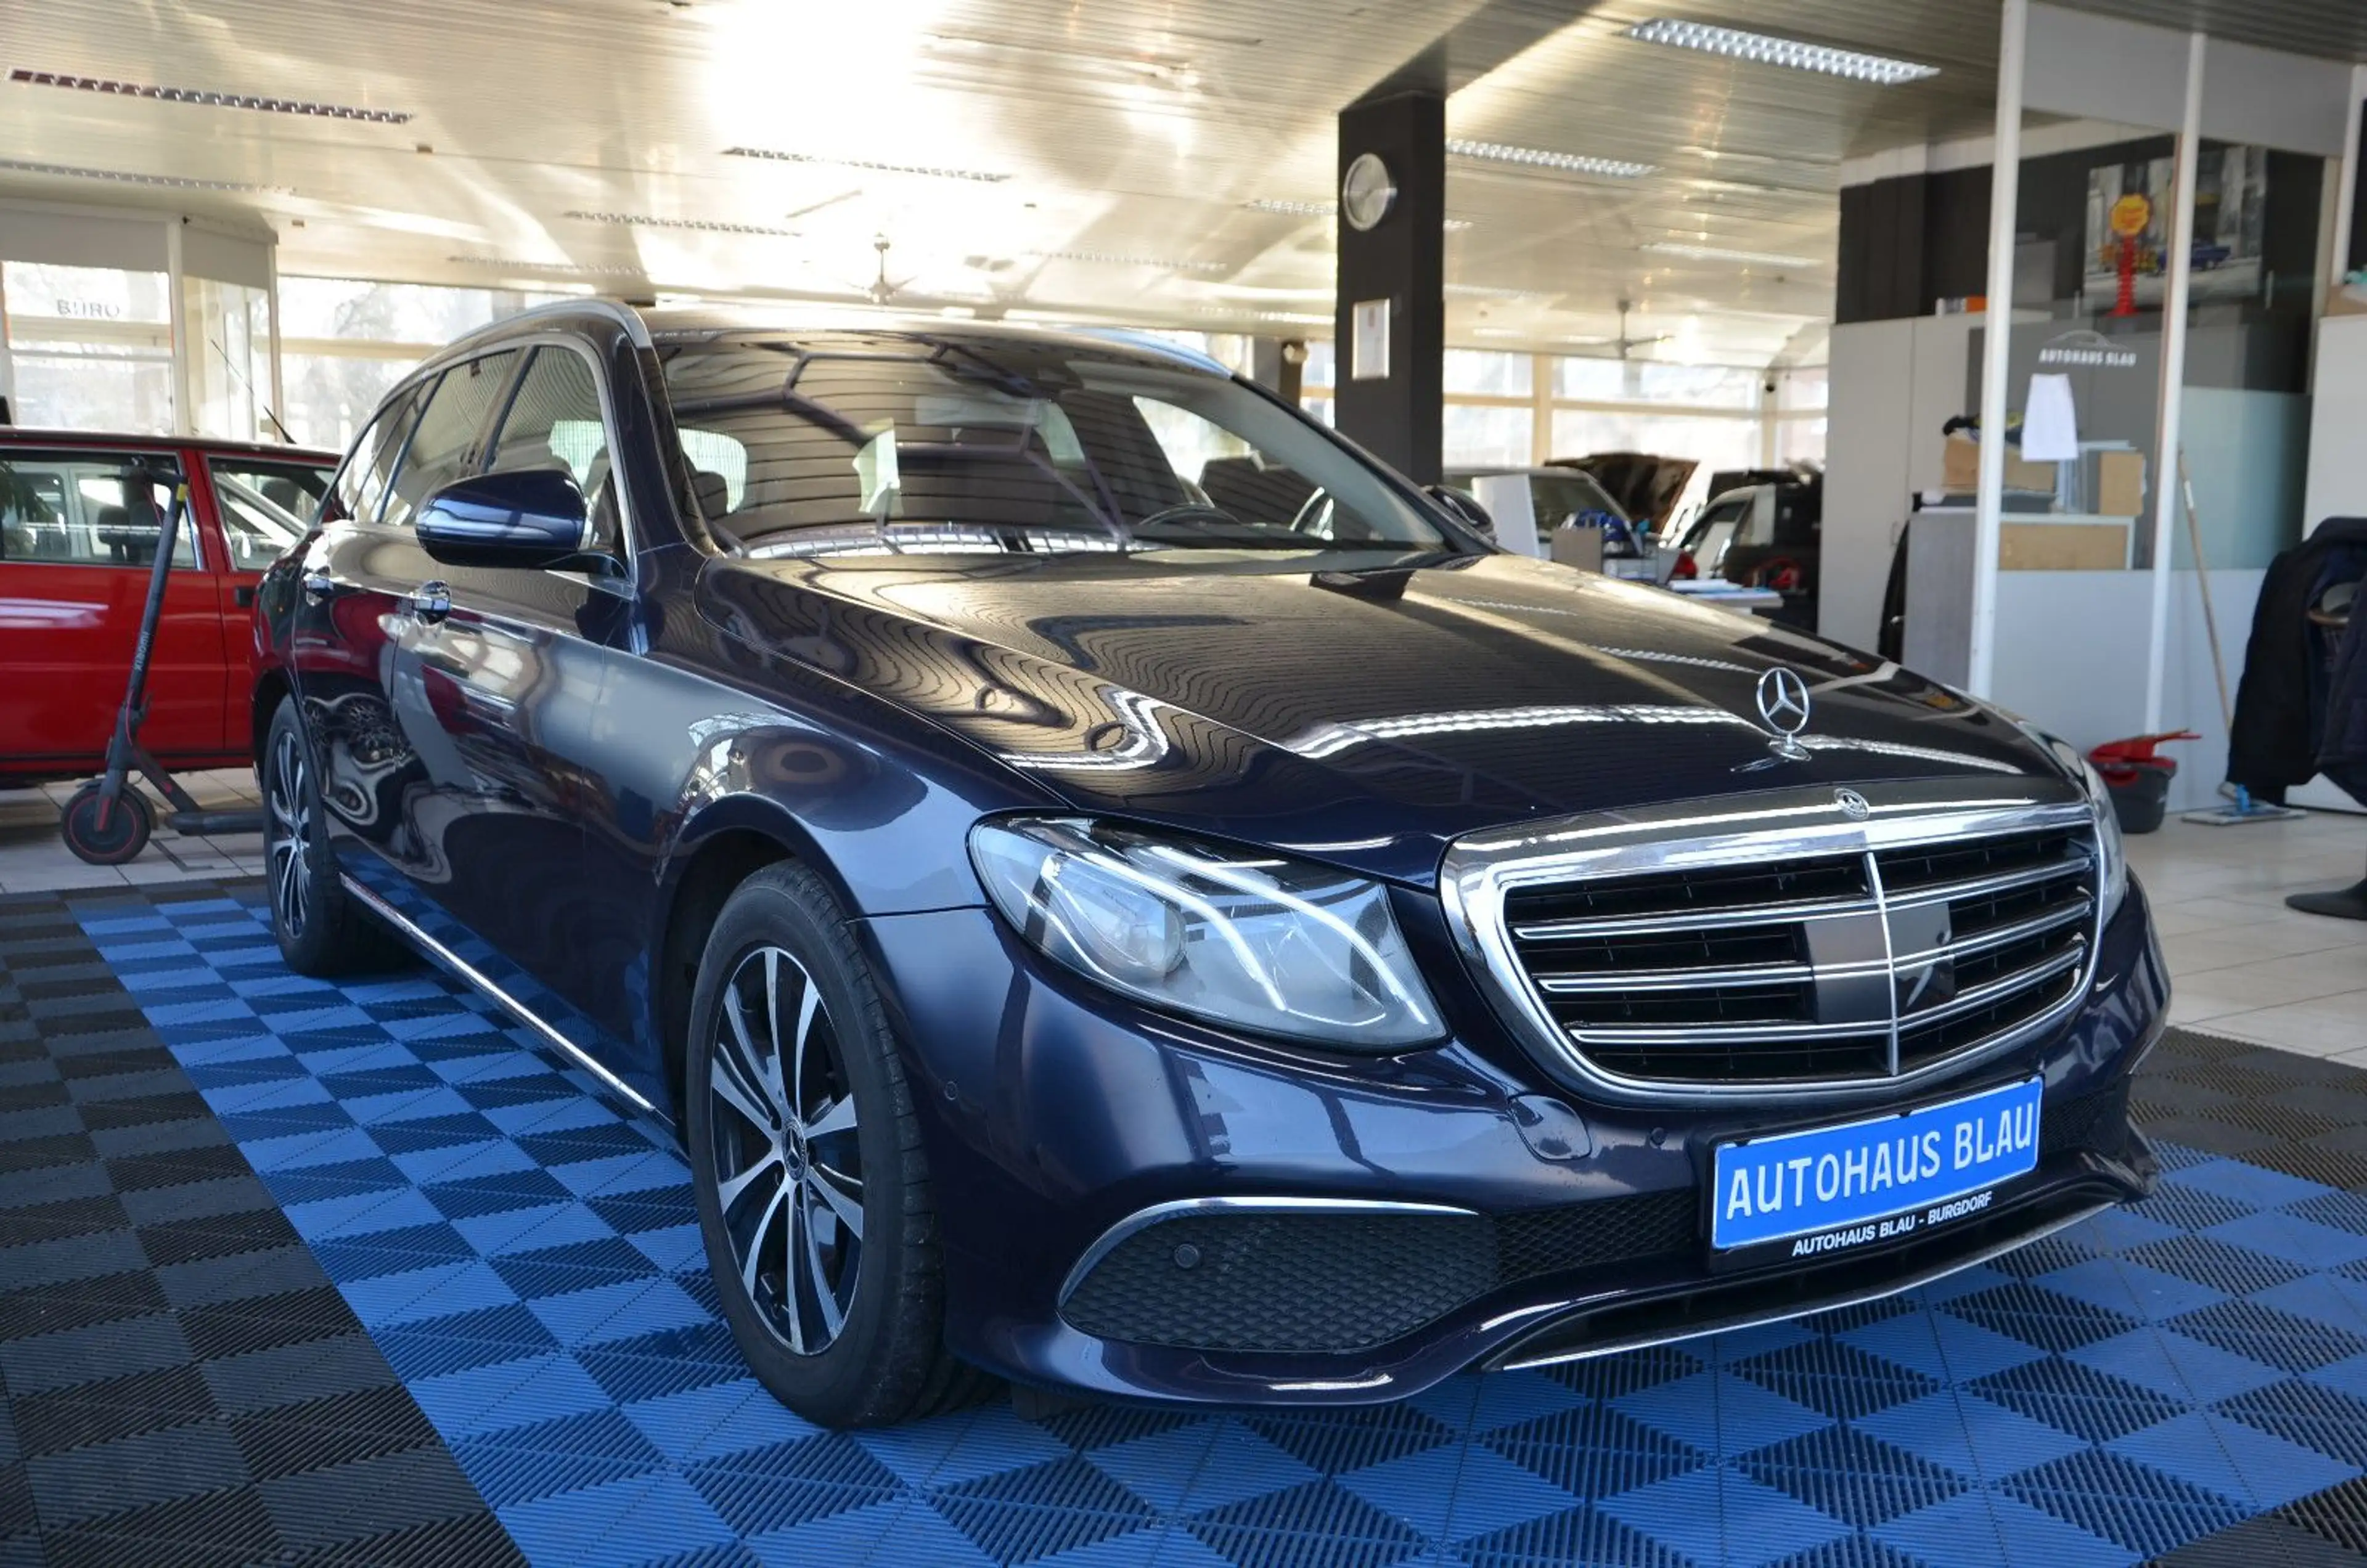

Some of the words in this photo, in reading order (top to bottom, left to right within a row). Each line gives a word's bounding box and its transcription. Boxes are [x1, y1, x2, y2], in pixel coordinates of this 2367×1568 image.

[2038, 347, 2103, 365] AUTOHAUS
[2105, 351, 2137, 368] BLAU
[1726, 1130, 1941, 1220] AUTOHAUS
[1953, 1101, 2034, 1170] BLAU
[1792, 1225, 1876, 1257] AUTOHAUS
[1879, 1214, 1916, 1238] BLAU
[1927, 1191, 1993, 1225] BURGDORF
